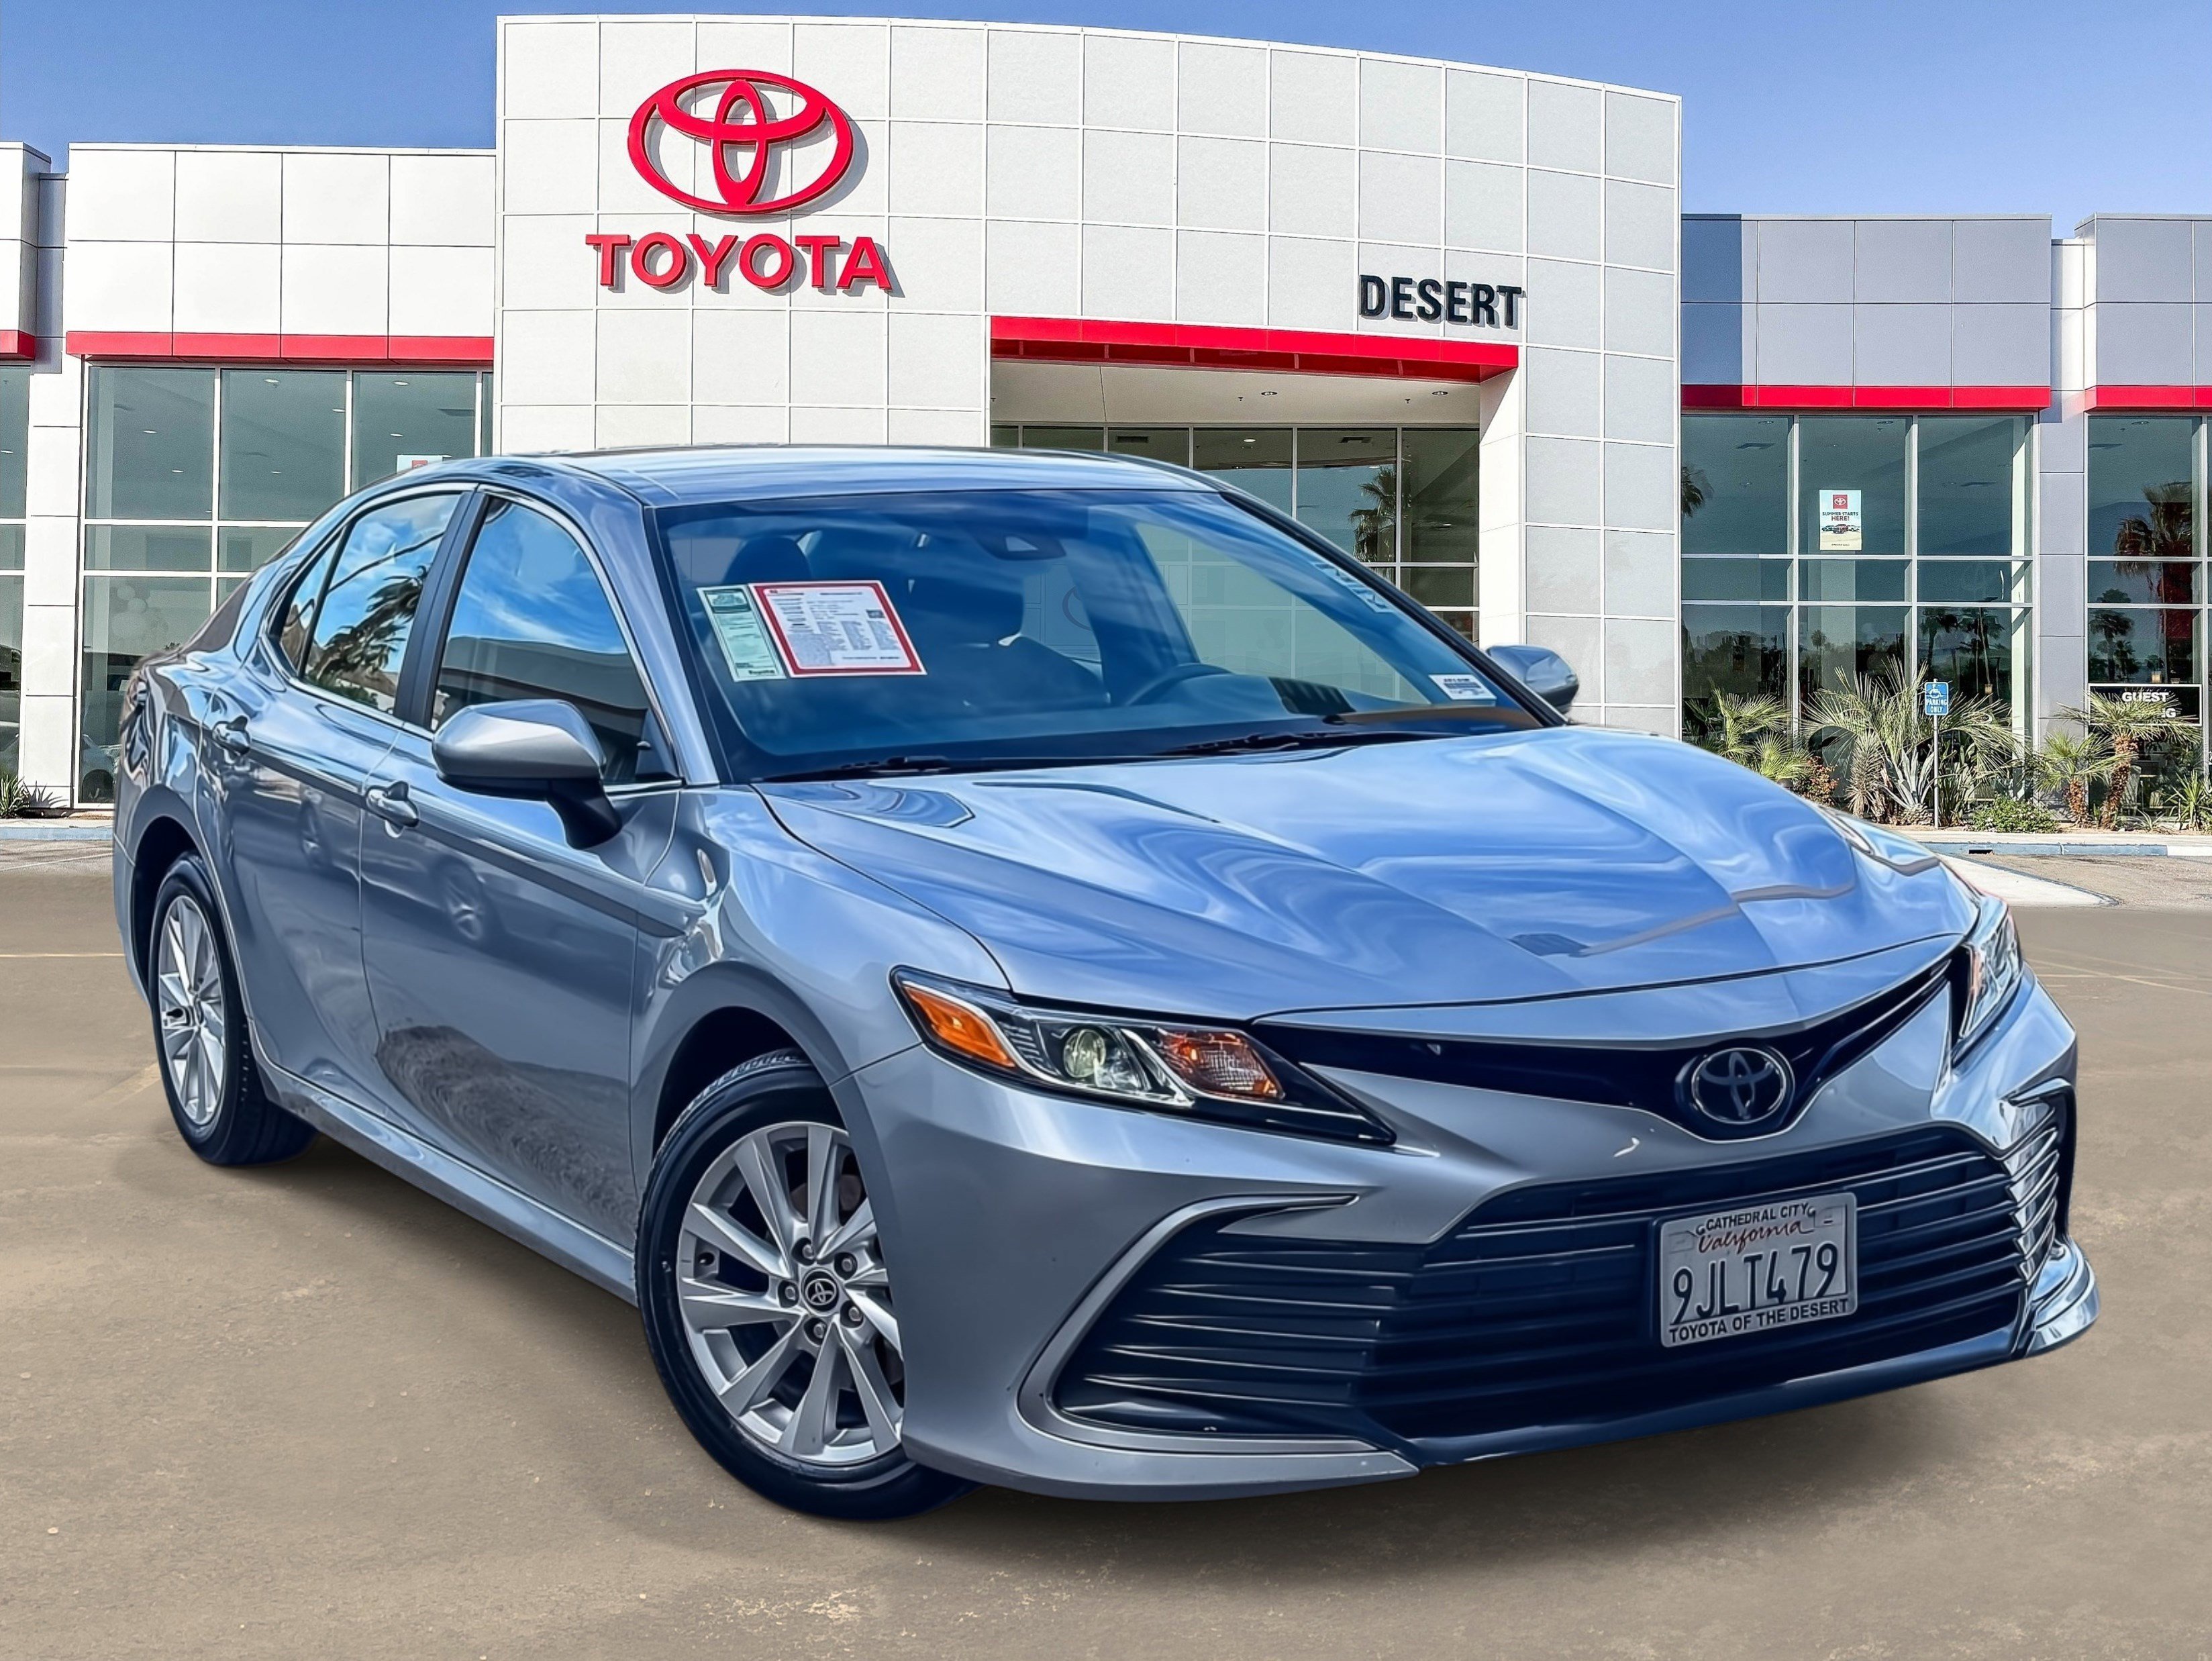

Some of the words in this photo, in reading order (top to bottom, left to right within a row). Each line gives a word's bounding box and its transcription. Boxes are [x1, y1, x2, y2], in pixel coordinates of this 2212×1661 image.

[585, 232, 893, 291] TOYOTA
[1359, 274, 1522, 328] DESERT
[1930, 705, 1943, 713] ONLY
[2121, 692, 2169, 702] GUEST
[1698, 1219, 1813, 1254] California
[1705, 1209, 1776, 1230] CATHEDRAL
[1780, 1203, 1809, 1219] CITY
[1670, 1242, 1838, 1325] 9JLT479
[1669, 1319, 1727, 1343] TOYOTA
[1731, 1314, 1752, 1331] OF
[1756, 1308, 1787, 1325] THE
[1789, 1298, 1848, 1321] DESERT
